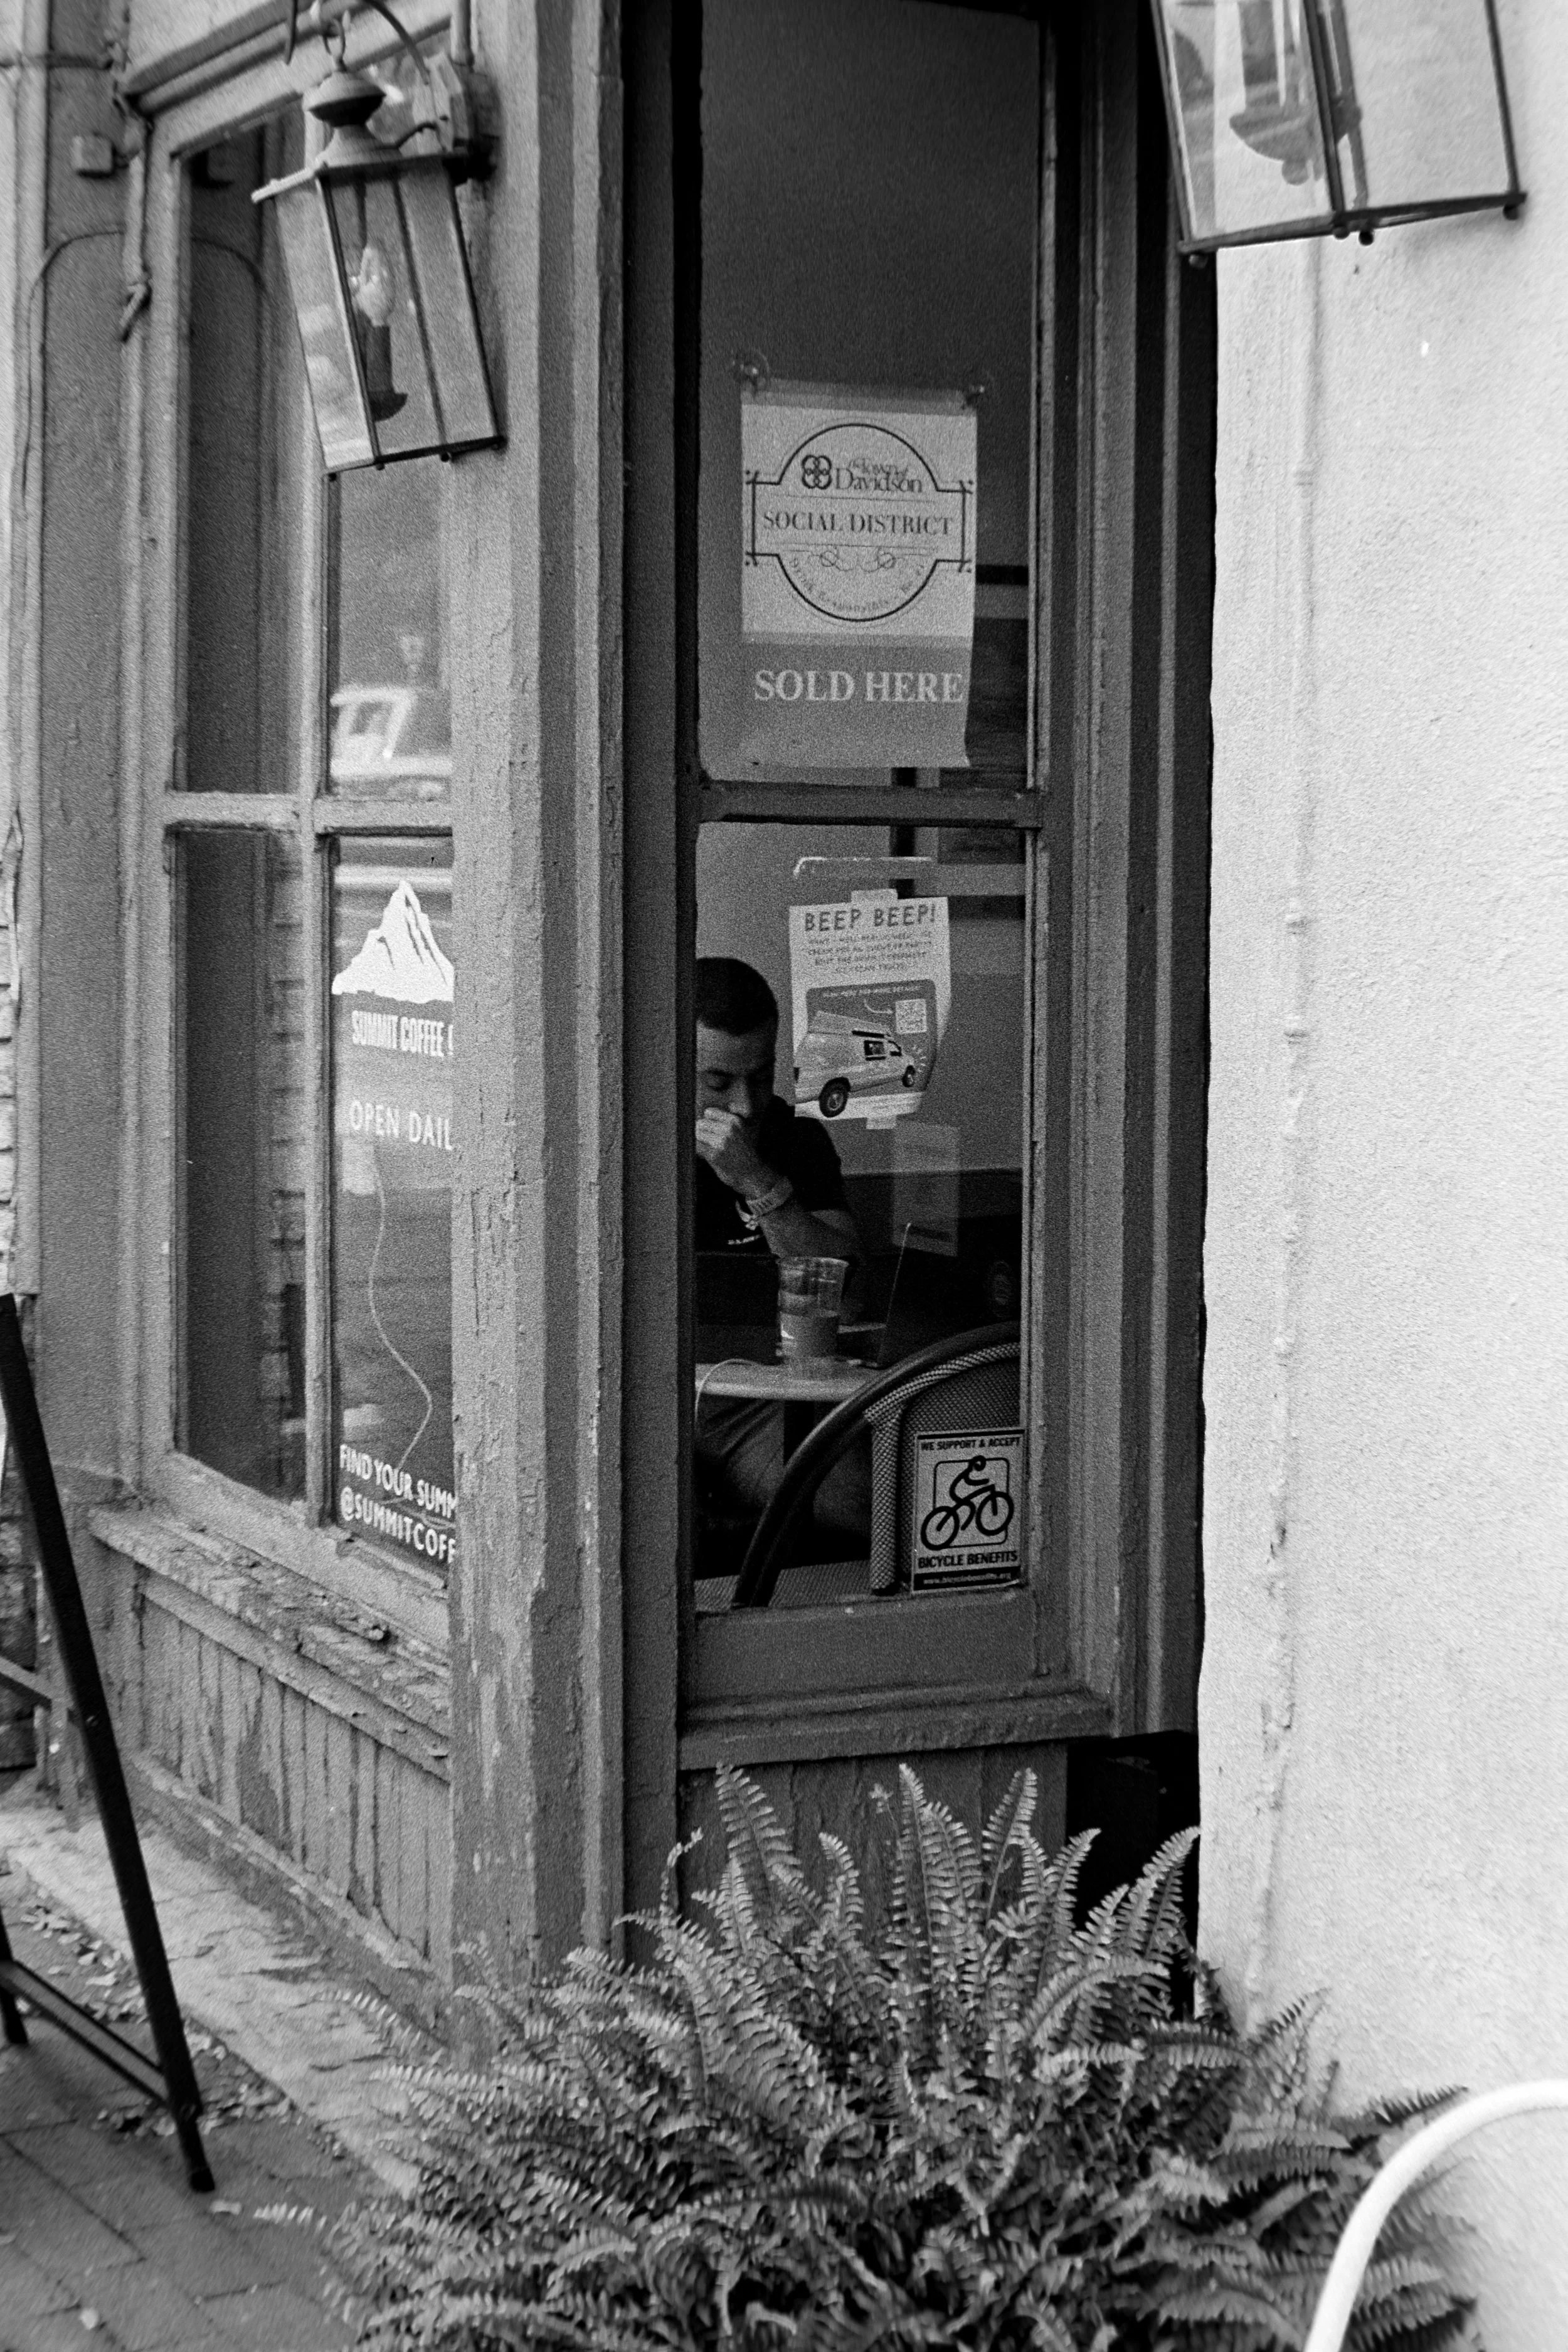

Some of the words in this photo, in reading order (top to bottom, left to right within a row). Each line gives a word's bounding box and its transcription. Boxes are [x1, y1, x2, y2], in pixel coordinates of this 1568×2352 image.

[835, 467, 923, 493] Davidson
[763, 510, 844, 532] SOCIAL
[850, 512, 953, 536] DISTRICT
[754, 669, 855, 702] SOLD
[866, 671, 964, 704] HERE
[805, 908, 861, 932] BEEP
[874, 904, 936, 928] BEEP!
[352, 1010, 398, 1049] SUMMIT
[400, 1016, 445, 1057] COFFEE
[349, 1099, 400, 1140] OPEN
[921, 1442, 935, 1451] WE
[937, 1439, 977, 1450] SUPPORT
[988, 1436, 1021, 1448] ACCEPT
[340, 1443, 373, 1480] FIND
[374, 1459, 415, 1501] YOUR
[918, 1554, 965, 1569] BICYCLE
[967, 1550, 1018, 1565] BENEFITS
